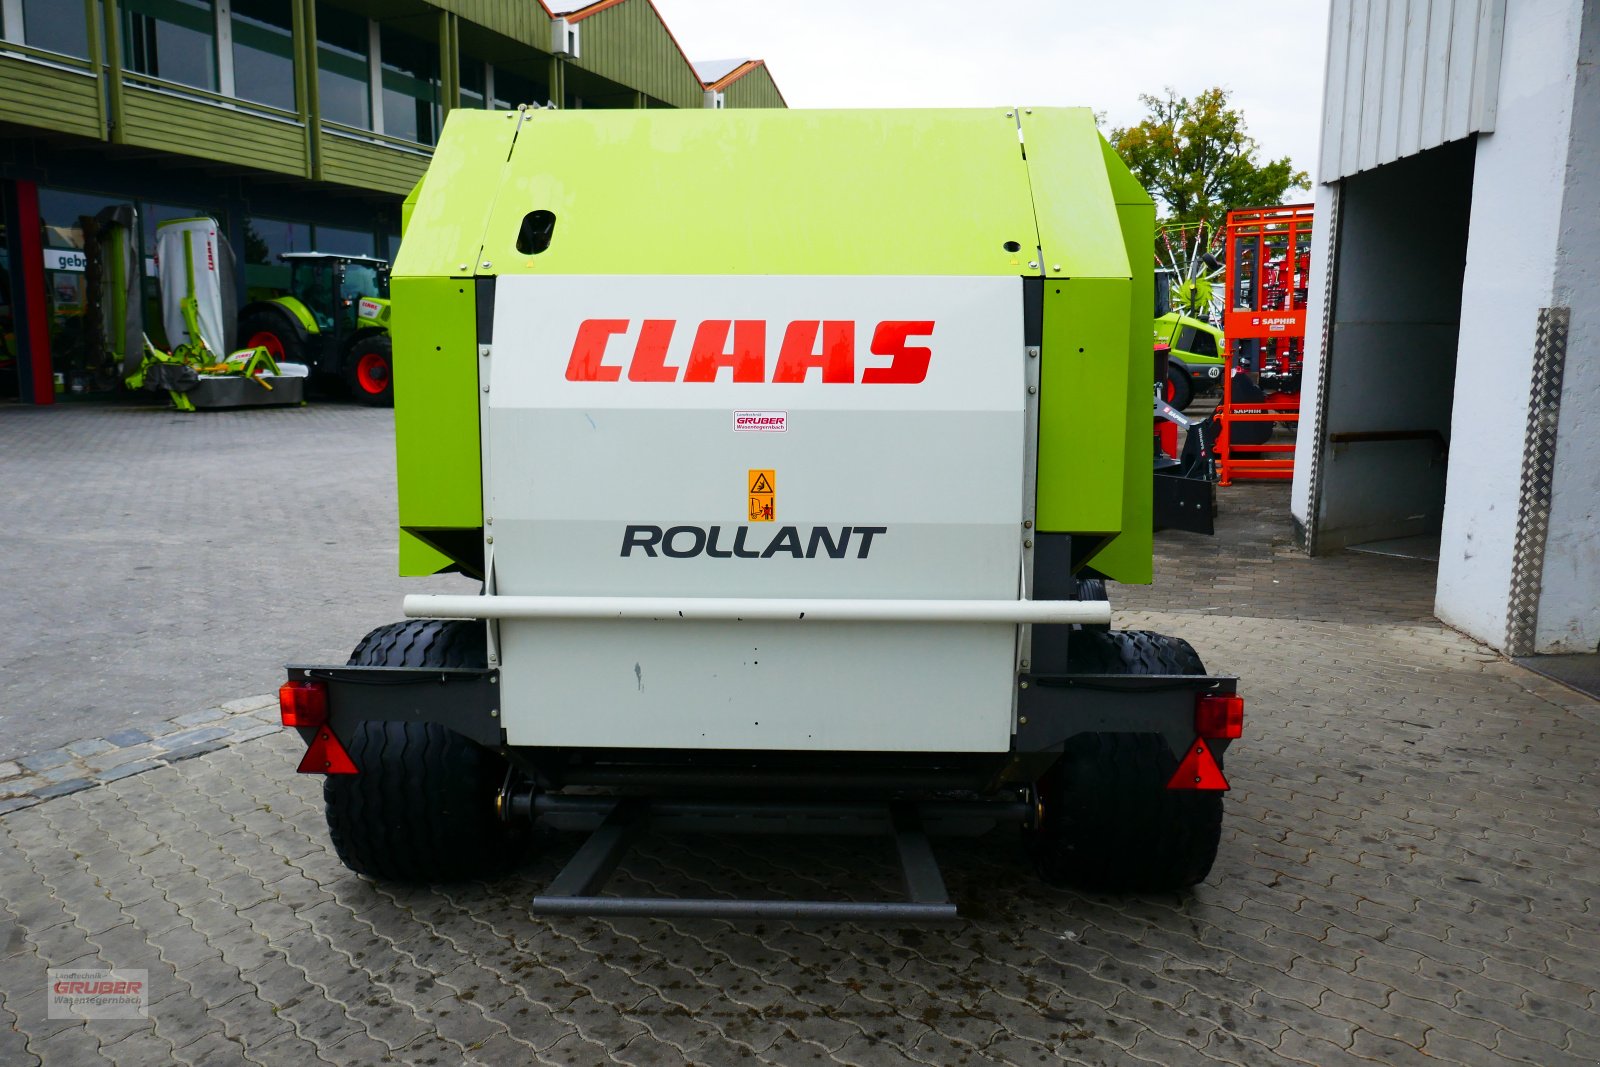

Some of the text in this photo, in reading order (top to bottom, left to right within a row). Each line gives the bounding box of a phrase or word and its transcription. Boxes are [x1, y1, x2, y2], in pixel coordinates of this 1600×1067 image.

[1262, 317, 1296, 325] SAPHIR
[564, 318, 936, 385] CLAAS
[1209, 368, 1218, 377] 40
[736, 417, 785, 425] GRUBER
[620, 524, 888, 560] ROLLANT
